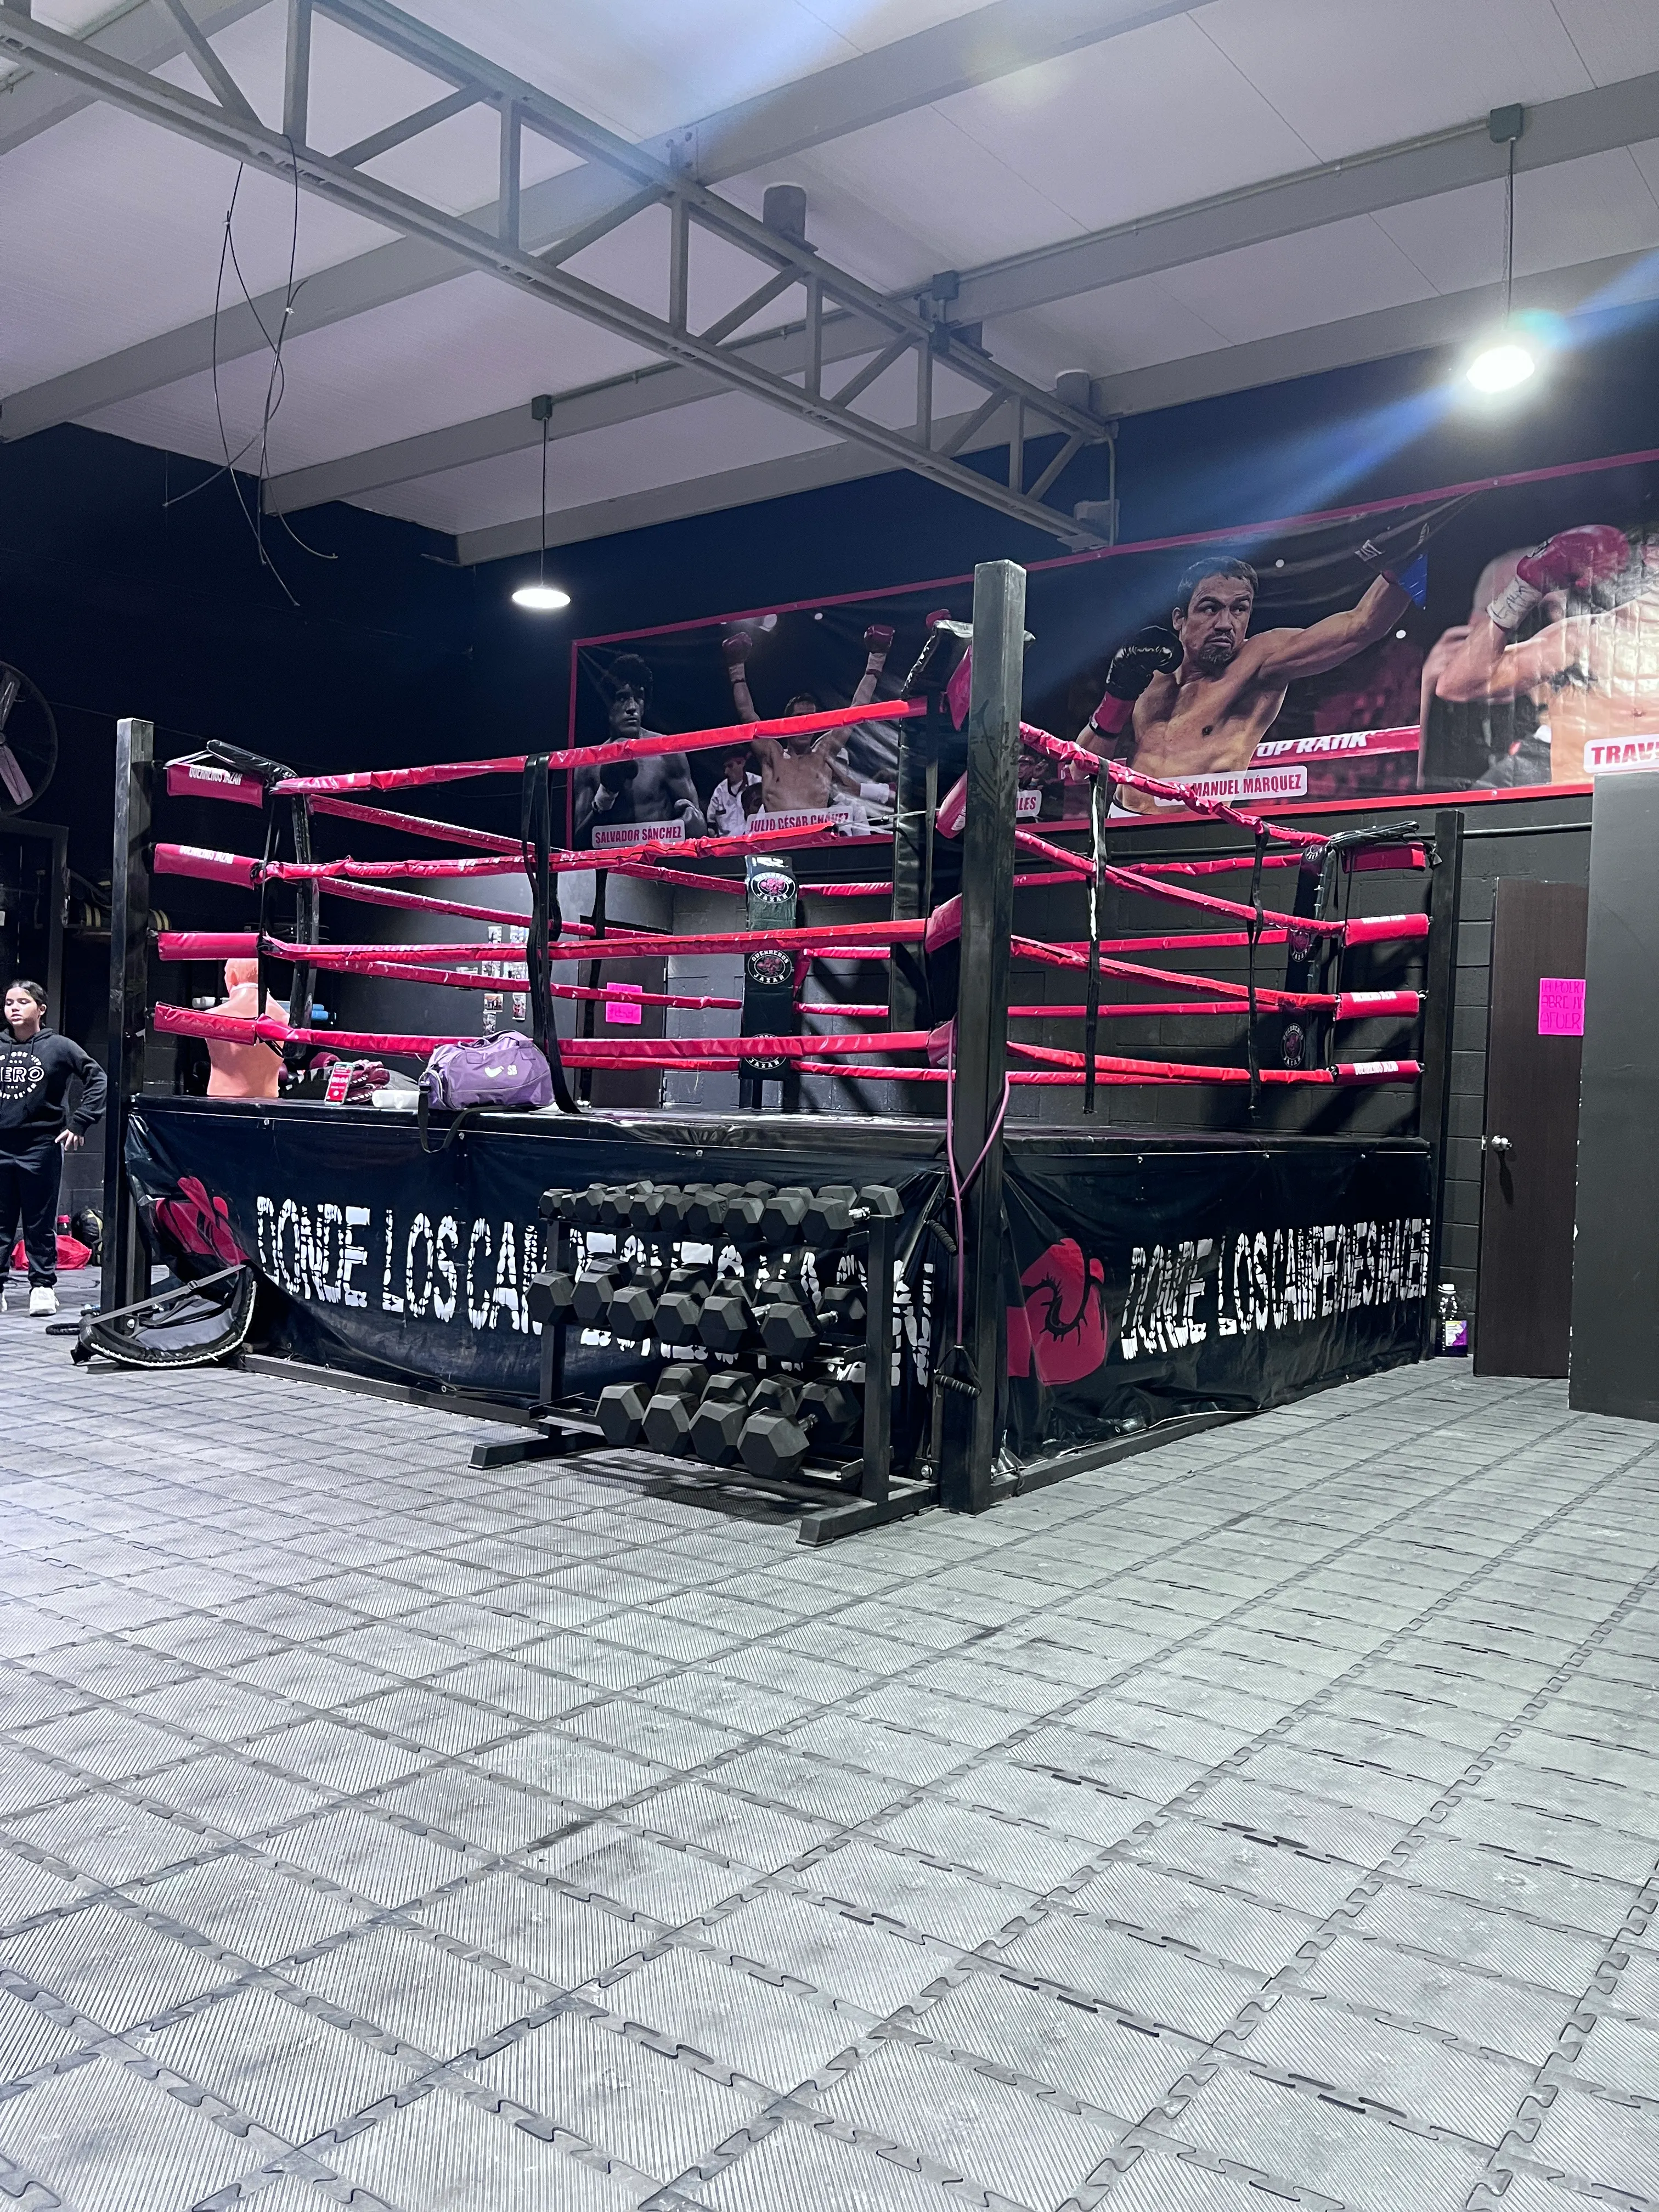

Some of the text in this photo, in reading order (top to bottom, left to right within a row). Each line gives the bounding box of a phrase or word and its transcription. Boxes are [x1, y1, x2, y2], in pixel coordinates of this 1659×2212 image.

[1193, 774, 1302, 797] MANUEL MÁRQUEZ
[595, 826, 682, 844] SALVADOR SÁNCHEZ
[749, 819, 776, 832] JULIO
[507, 1065, 518, 1076] SB
[257, 1196, 370, 1308] DONDE
[382, 1209, 459, 1323] LOS
[1121, 1238, 1213, 1360] DONDE
[1217, 1231, 1268, 1336] LOS
